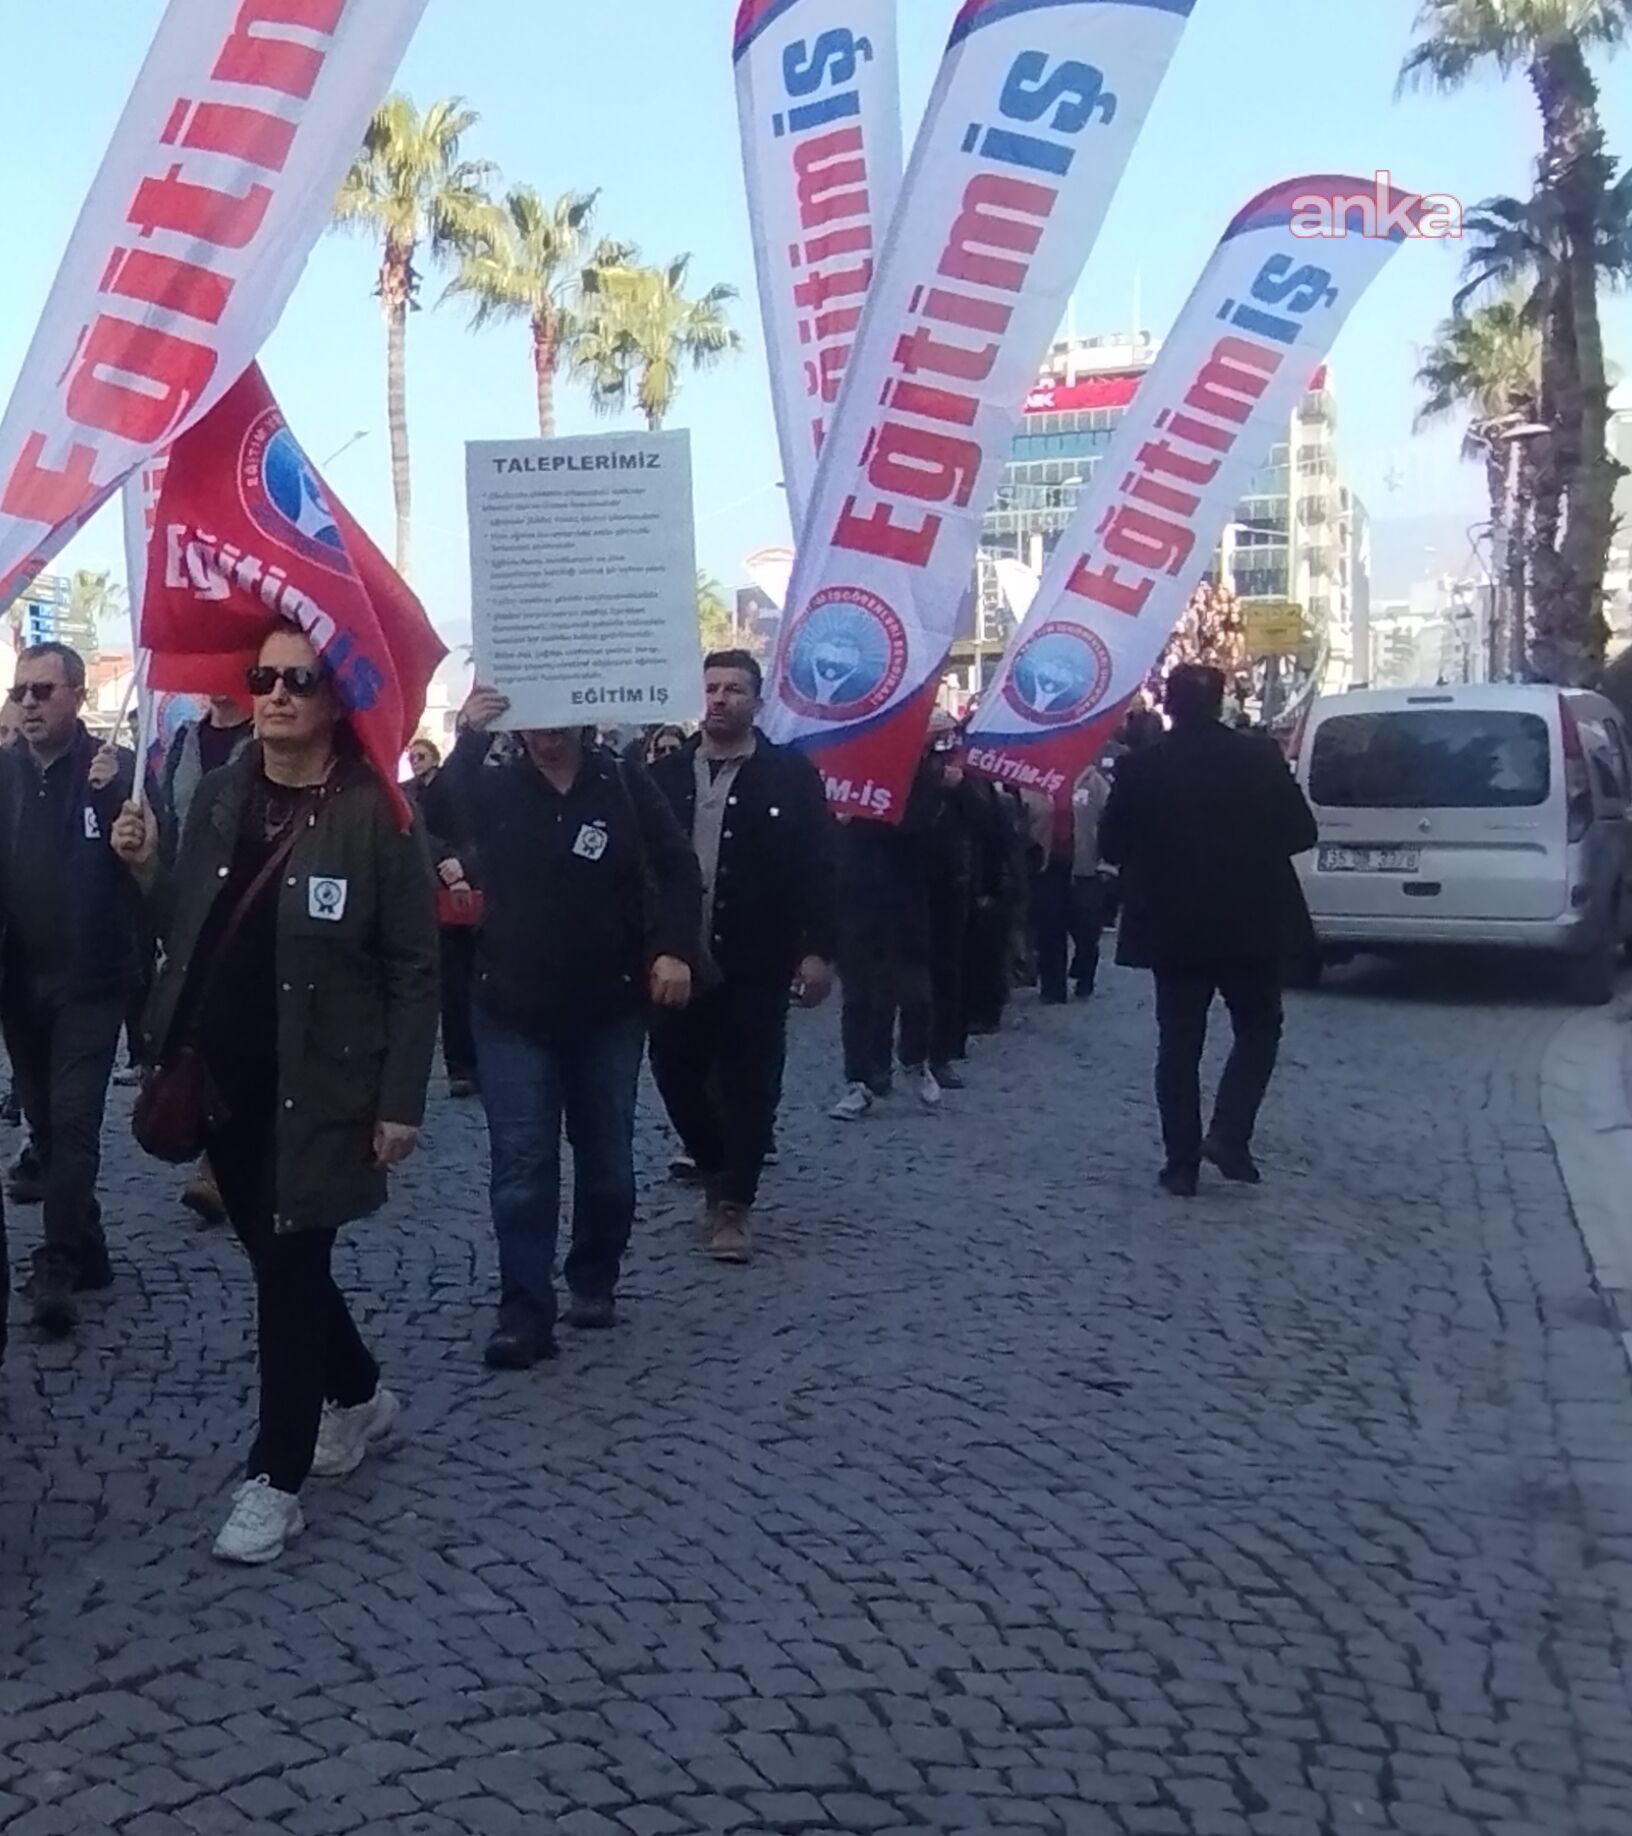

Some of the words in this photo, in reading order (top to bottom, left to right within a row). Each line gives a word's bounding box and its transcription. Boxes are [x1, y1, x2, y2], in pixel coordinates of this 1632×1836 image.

[493, 451, 661, 474] TALEPLERİMİZ
[570, 685, 643, 706] EĞİTİM
[649, 686, 669, 708] İŞ
[966, 747, 1066, 791] EĞİTİM-İŞ
